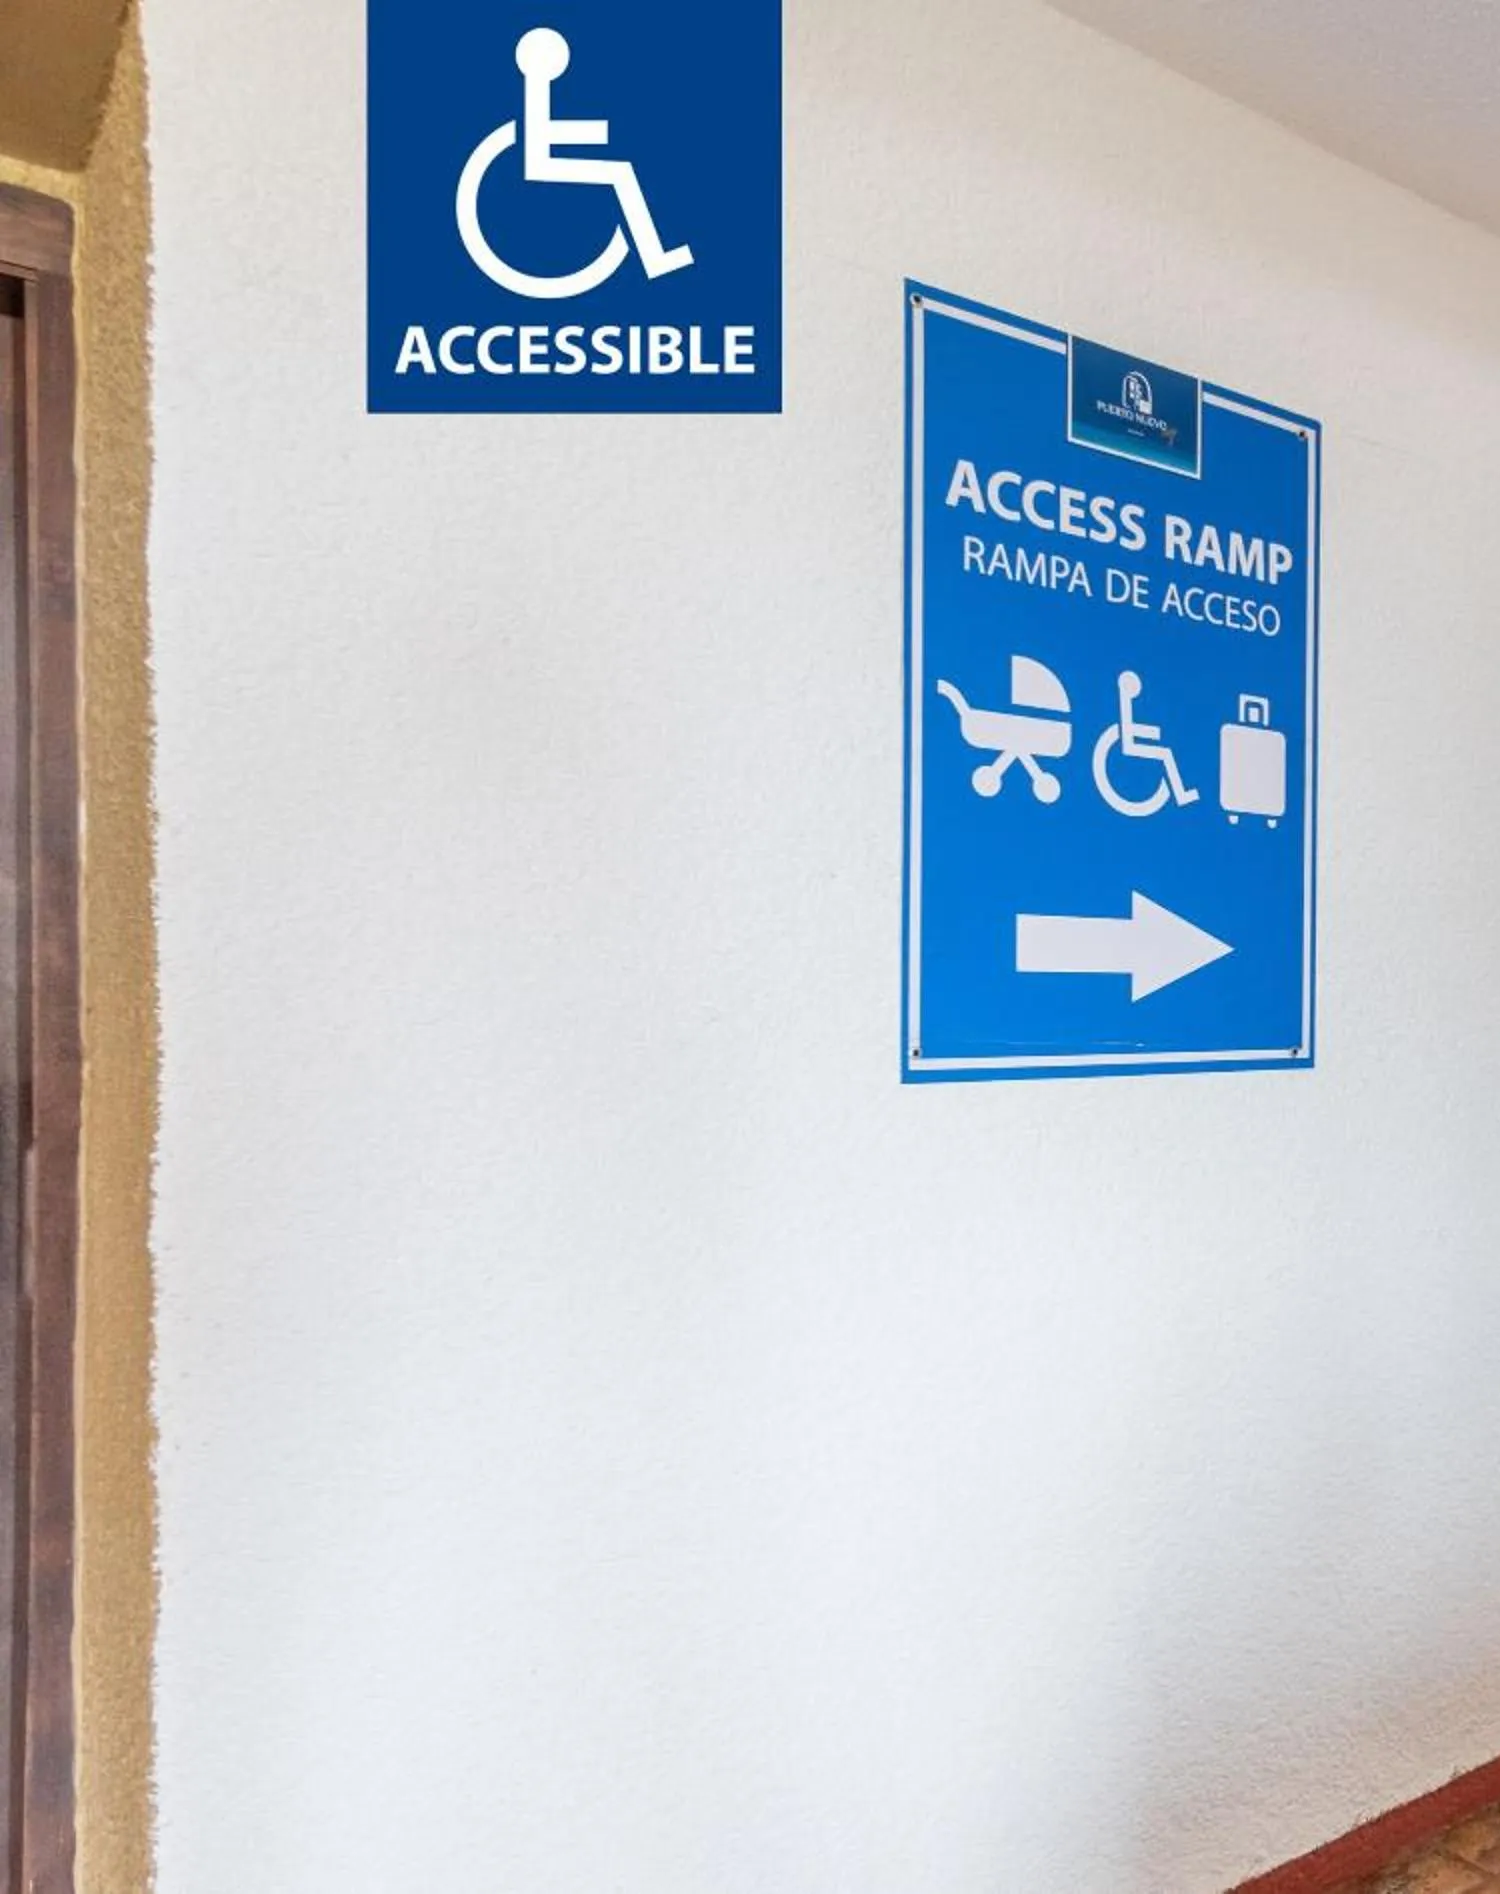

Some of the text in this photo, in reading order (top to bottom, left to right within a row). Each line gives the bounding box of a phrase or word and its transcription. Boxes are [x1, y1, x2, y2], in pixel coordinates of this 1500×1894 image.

[945, 459, 1293, 585] ACCESS RAMP
[963, 535, 1281, 637] RAMPA DE ACCESO
